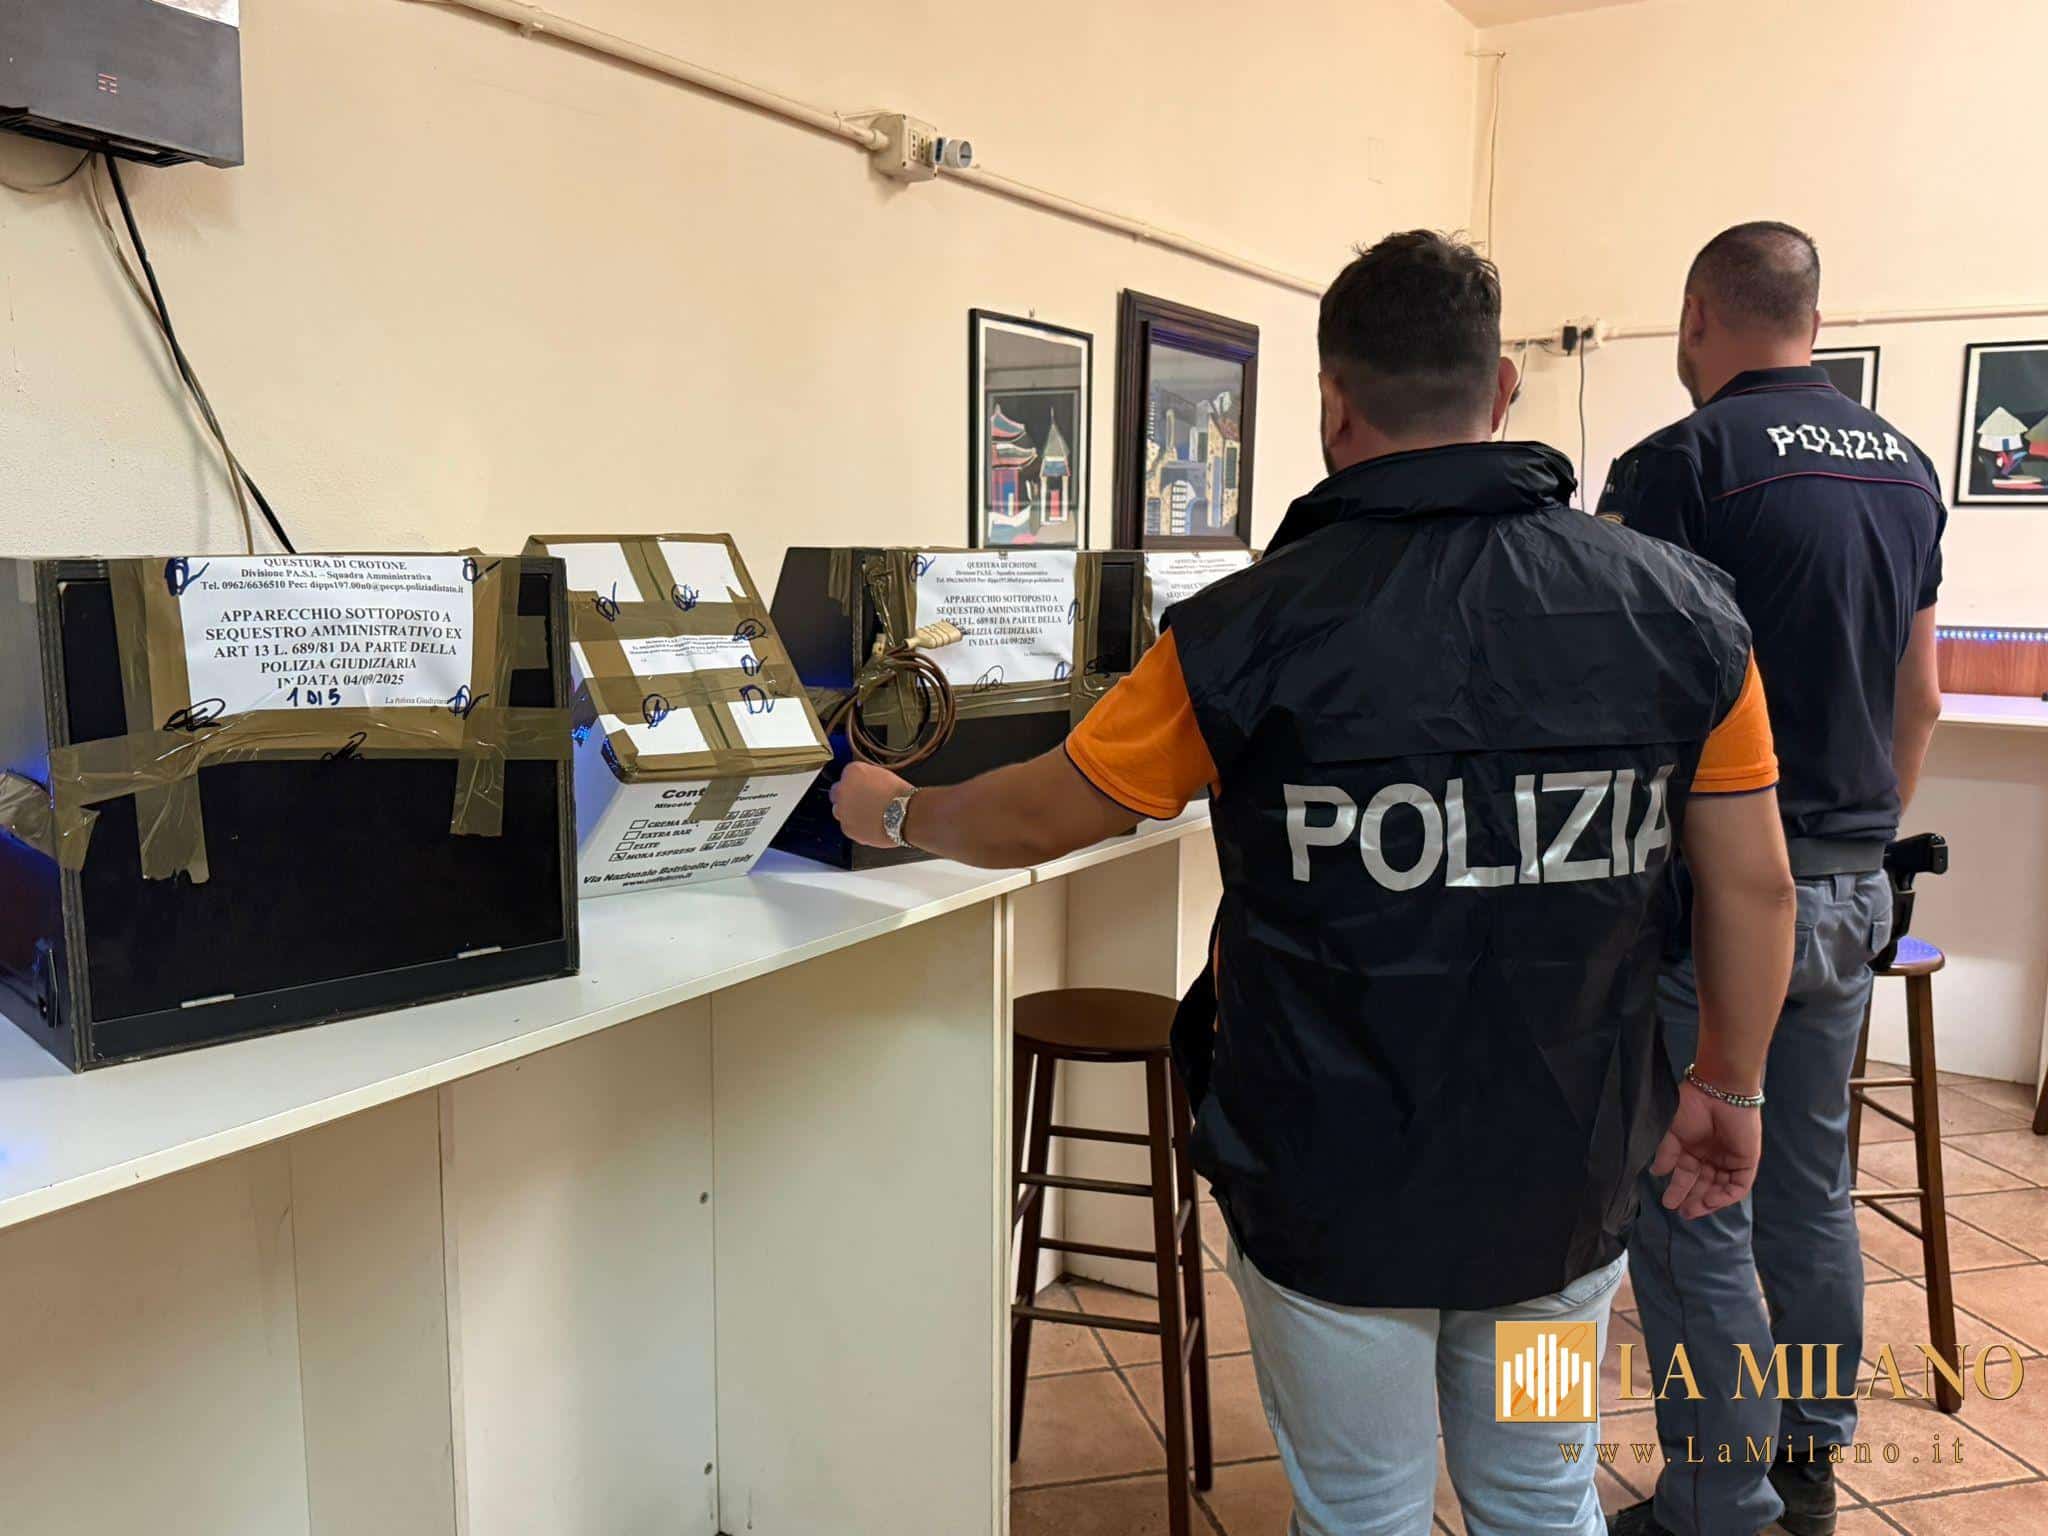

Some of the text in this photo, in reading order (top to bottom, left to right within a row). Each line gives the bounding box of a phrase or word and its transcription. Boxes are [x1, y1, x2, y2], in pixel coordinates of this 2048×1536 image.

[1766, 423, 1909, 463] POLIZIA
[264, 558, 407, 570] QUESTURA DI CROTONE
[241, 569, 284, 578] Divisione
[327, 571, 364, 581] Squadra
[366, 572, 432, 581] Amministrativa
[200, 581, 220, 590] Tel.
[222, 579, 286, 590] 0962/6636510
[288, 580, 308, 589] Pec:
[944, 595, 1001, 604] APPARECCHIO
[220, 607, 452, 622] APPARECCHIO SOTTOPOSTO A
[936, 606, 985, 615] SEQUESTRO
[206, 624, 463, 642] SEQUESTRO AMMINISTRATIVO EX
[214, 641, 457, 658] ART 13 L. 689/81 DA PARTE DELLA
[261, 657, 417, 673] POLIZIA GIUDIZIARIA
[296, 672, 338, 686] DATA
[343, 672, 404, 686] 04/09/2025
[648, 820, 680, 828] CREMA
[1283, 763, 1678, 892] POLIZIA
[640, 829, 693, 839] EXTRA BAR
[633, 842, 661, 850] ELITE
[626, 851, 654, 860] MOKA
[583, 875, 602, 884] Via
[603, 869, 657, 882] Nazionale
